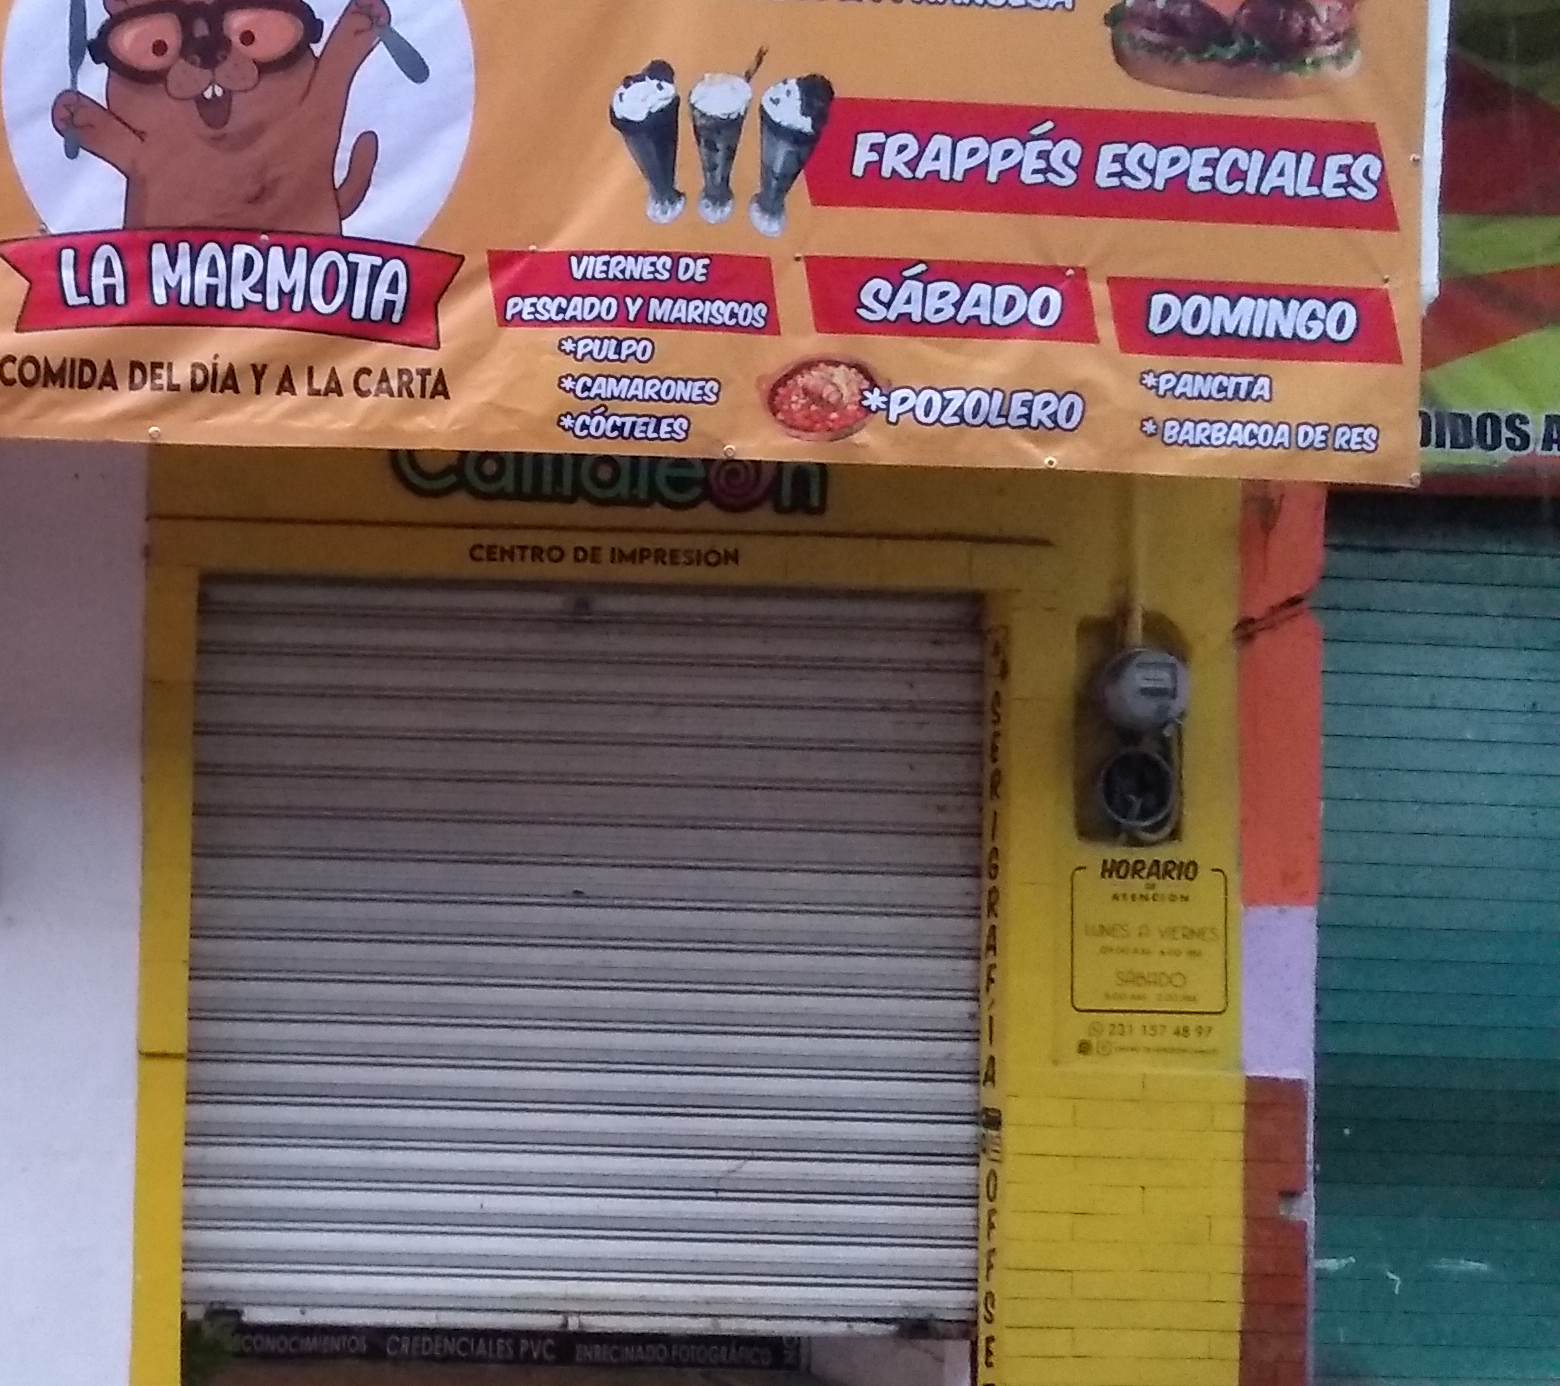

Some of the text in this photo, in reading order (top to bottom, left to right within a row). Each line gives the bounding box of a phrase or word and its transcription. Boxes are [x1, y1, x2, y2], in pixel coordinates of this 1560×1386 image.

[851, 120, 1382, 203] FRAPPÉS ESPECIALES
[59, 240, 410, 324] LA MARMOTA
[569, 254, 710, 284] VIERNES DE
[855, 262, 1064, 329] SÁBADO
[504, 296, 769, 329] PESCADO Y MARISCOS
[1146, 292, 1359, 344] DOMINGO
[127, 360, 181, 393] DEL
[190, 353, 240, 395] DÍA
[250, 363, 267, 396] Y
[275, 365, 298, 398] A
[307, 366, 344, 398] LA
[352, 366, 451, 401] CARTA
[1162, 419, 1379, 453] BARBACOA DE RES
[468, 543, 565, 563] CENTRO
[573, 546, 603, 563] DE
[1100, 858, 1199, 881] HORARIO
[1084, 923, 1130, 939] LUNES
[1158, 925, 1220, 942] VIERNES
[386, 1335, 514, 1359] CREDENCIALES
[519, 1338, 556, 1361] PVC
